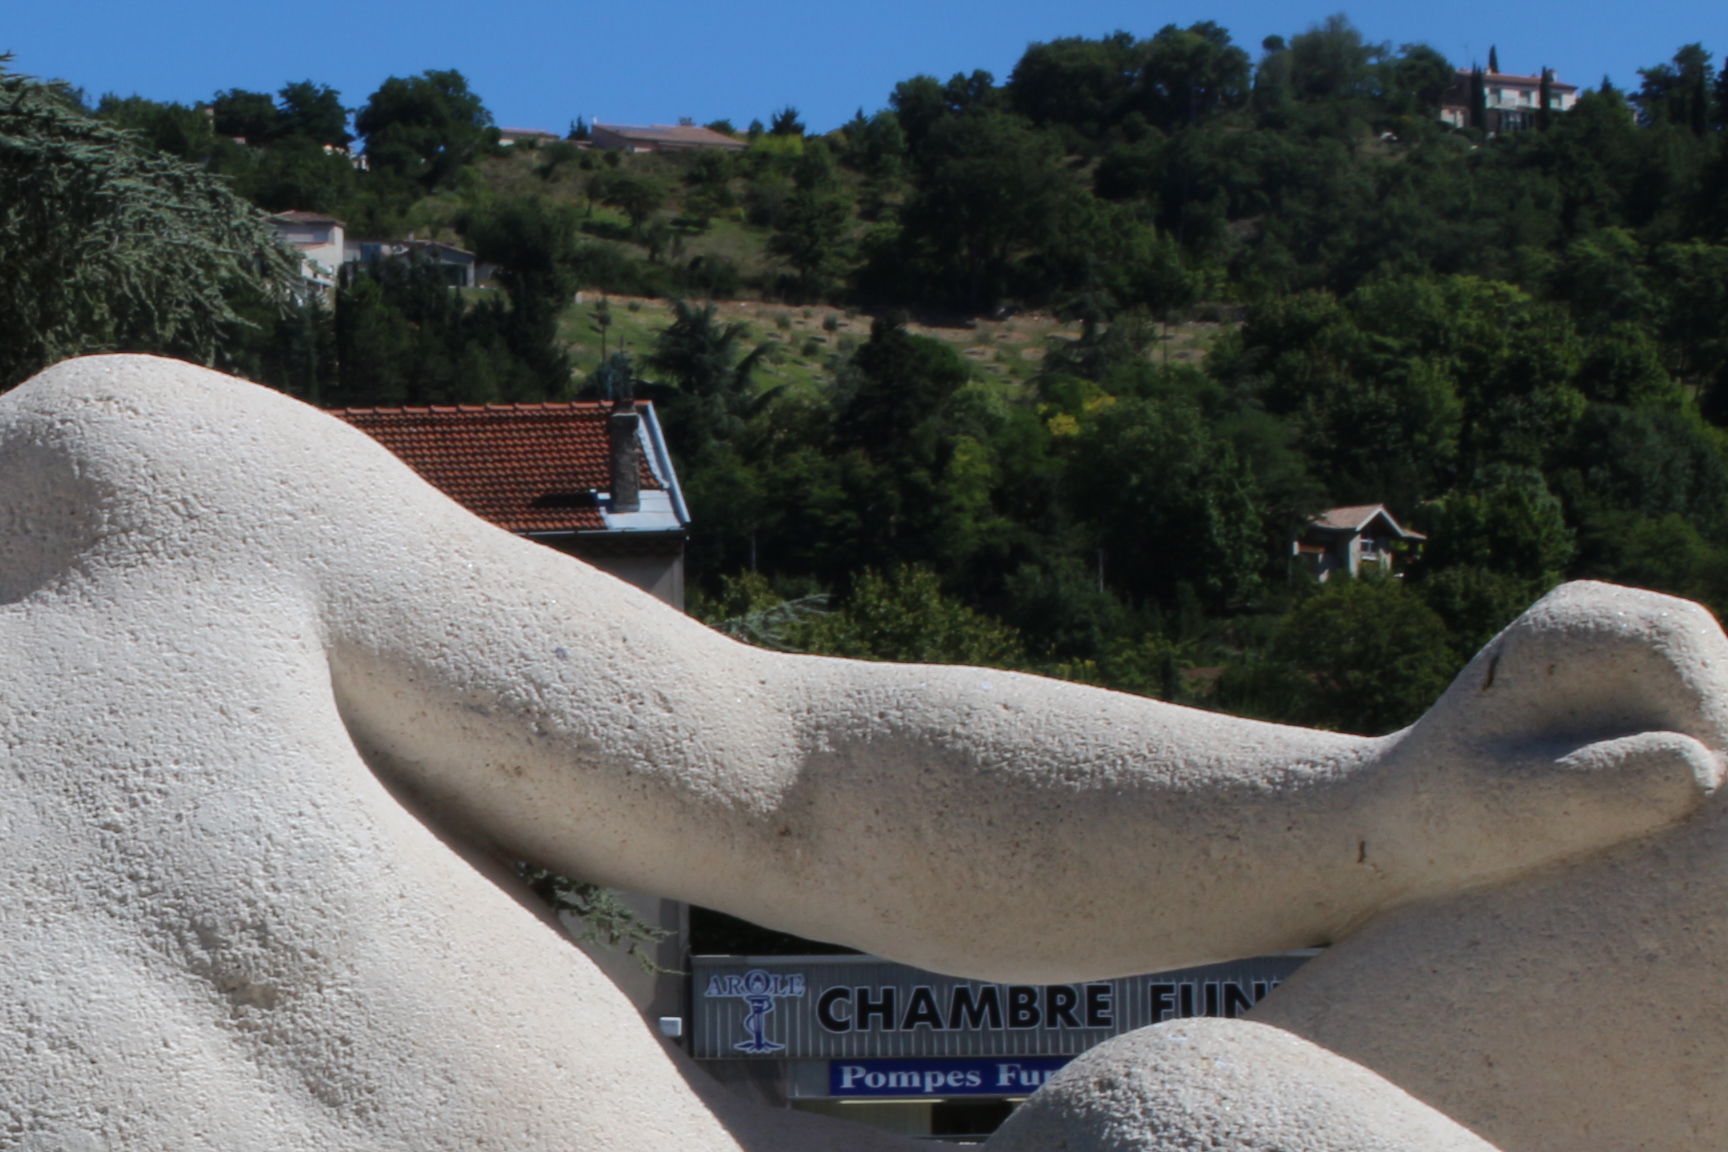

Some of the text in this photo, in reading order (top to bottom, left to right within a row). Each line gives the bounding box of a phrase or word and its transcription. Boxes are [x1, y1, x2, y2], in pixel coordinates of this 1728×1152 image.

[704, 969, 806, 997] AROLE
[817, 981, 1281, 1033] CHAMBRE FUN
[839, 1065, 982, 1092] Pompes
